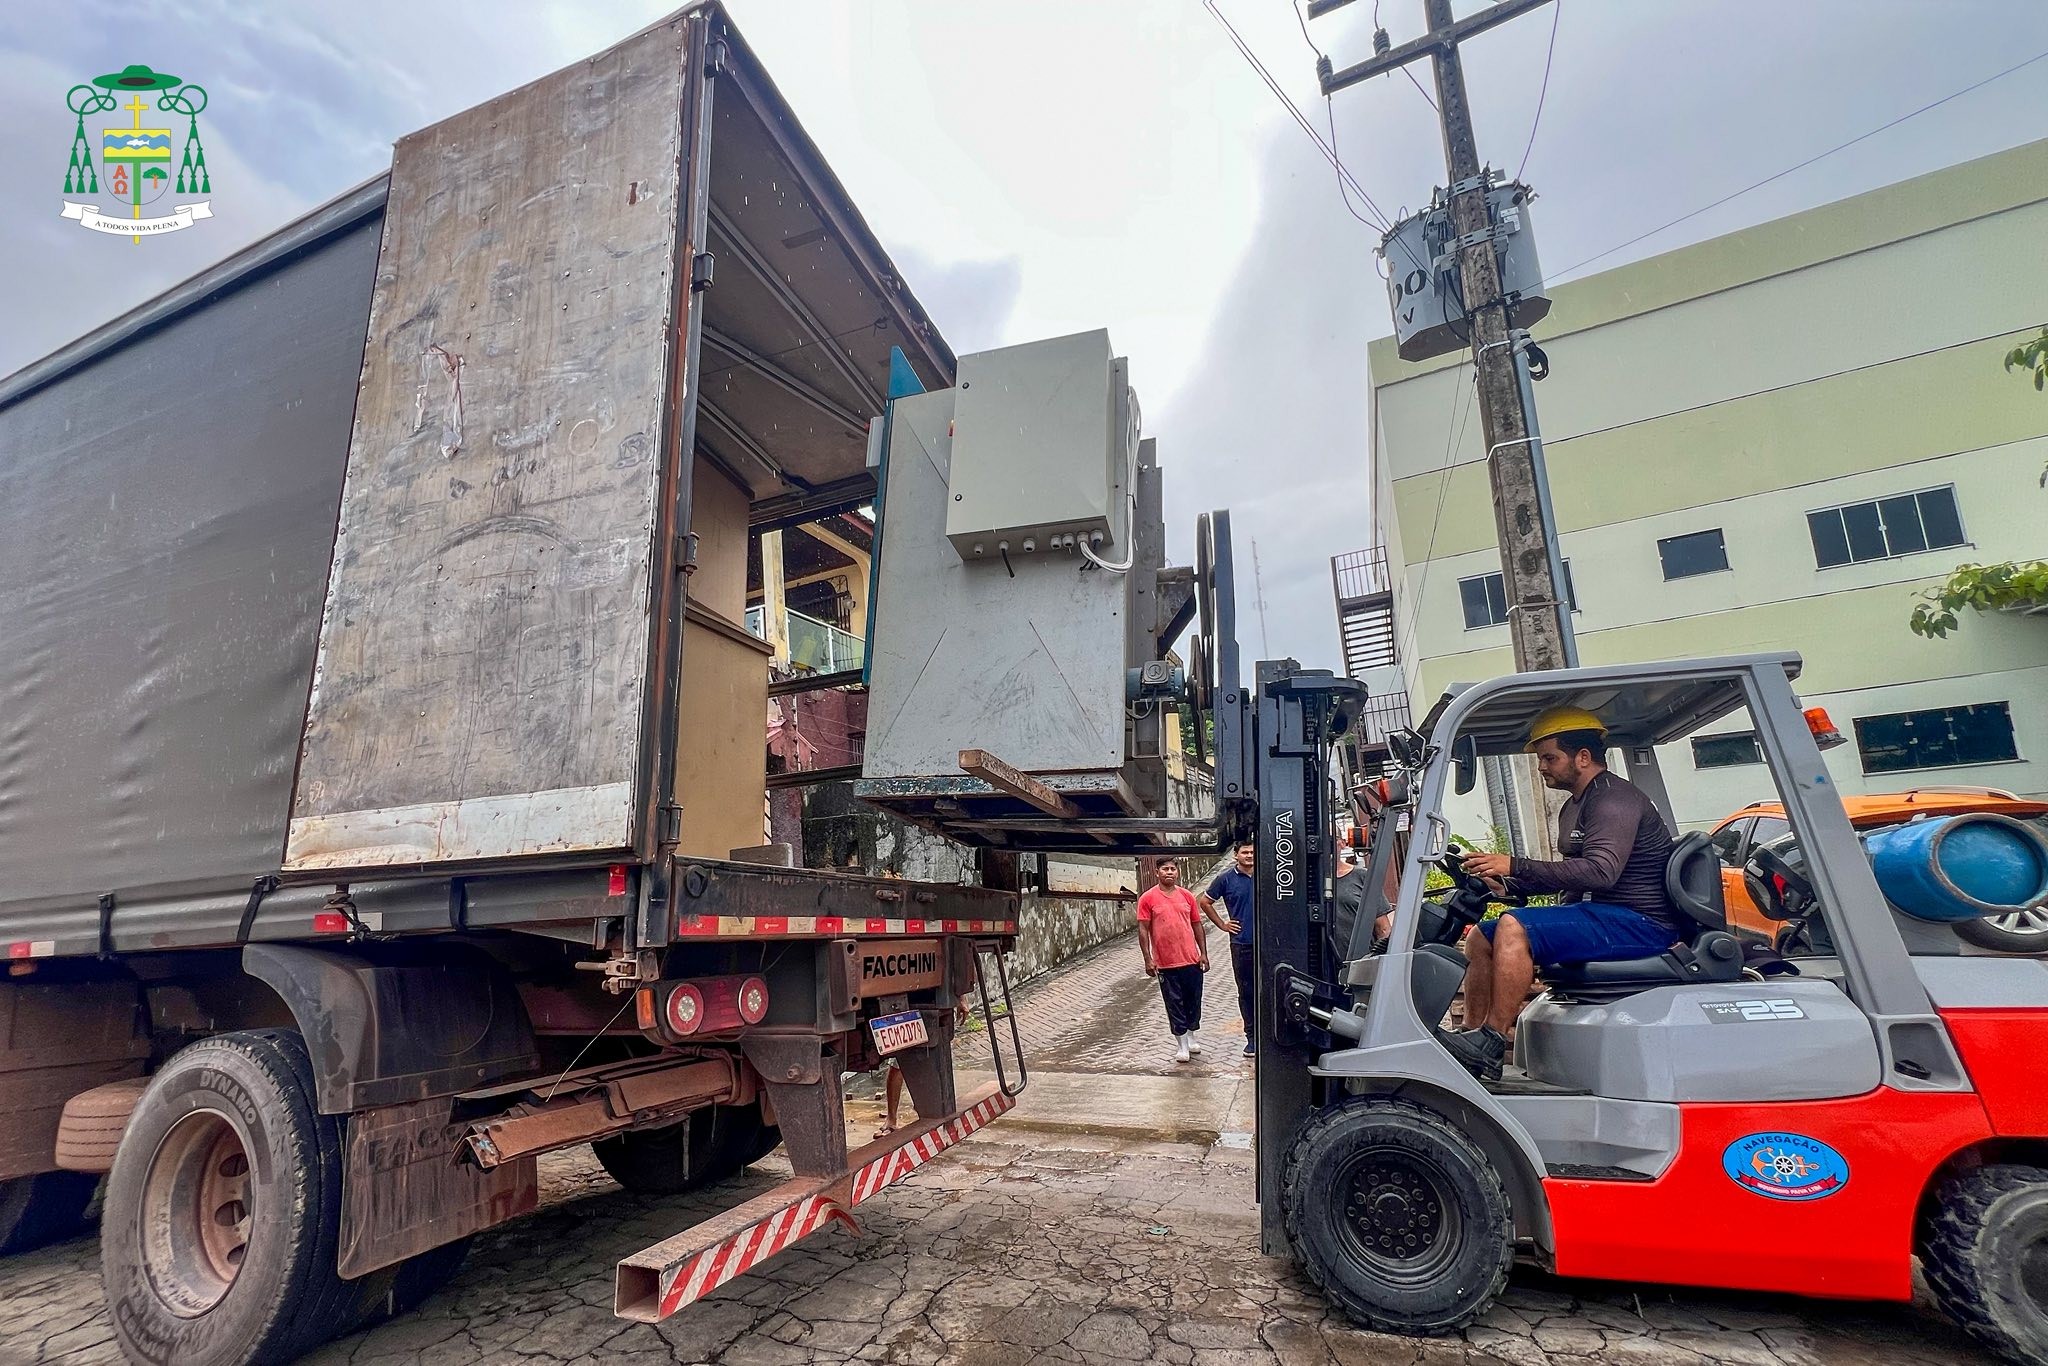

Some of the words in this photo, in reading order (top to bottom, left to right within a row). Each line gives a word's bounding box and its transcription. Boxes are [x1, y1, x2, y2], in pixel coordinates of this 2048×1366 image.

[1275, 810, 1294, 900] TOYOTA
[863, 951, 936, 979] FACCHINI
[1735, 998, 1804, 1021] 25
[879, 1021, 923, 1049] ECM2D79
[198, 1069, 258, 1126] DYNAMO
